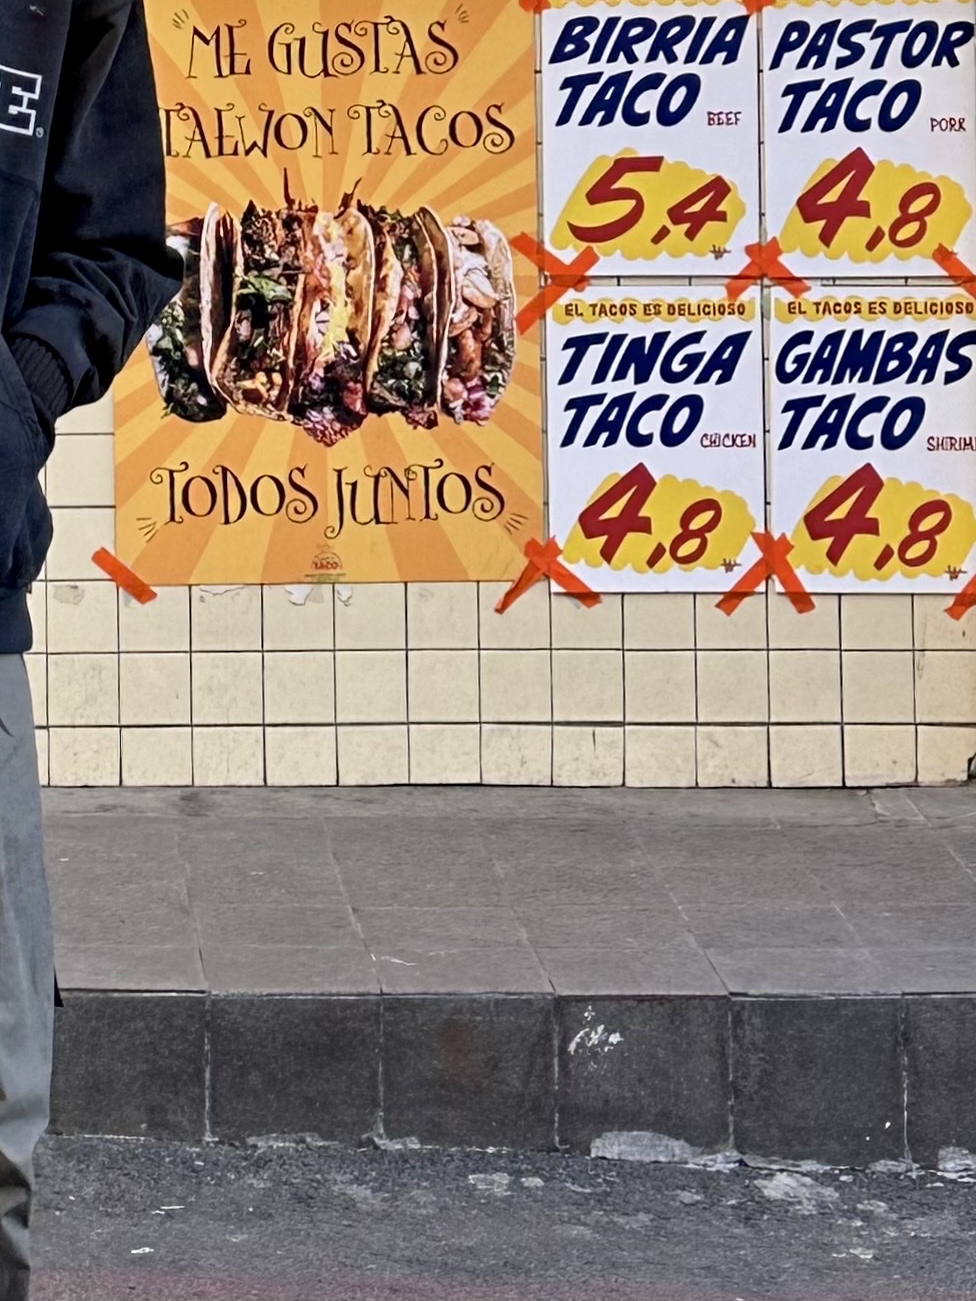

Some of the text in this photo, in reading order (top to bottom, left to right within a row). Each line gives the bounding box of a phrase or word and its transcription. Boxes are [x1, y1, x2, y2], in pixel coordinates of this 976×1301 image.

[184, 16, 461, 80] ME GUSTAS
[548, 13, 750, 67] BIRRIA
[769, 18, 975, 71] PASTOR
[555, 69, 742, 128] TACO BEEF
[777, 75, 967, 134] TACO PORK
[158, 98, 516, 159] TAEWON TACOS
[564, 302, 746, 317] EL TACOS ES DELICIOSO
[787, 300, 974, 315] EL TACOS ES DELICIOSO
[557, 330, 752, 386] TINGA
[775, 329, 976, 386] GAMBAS
[559, 391, 756, 449] TACO CHICKEN
[777, 393, 926, 451] TACO
[149, 457, 507, 539] TODOS JUNTOS
